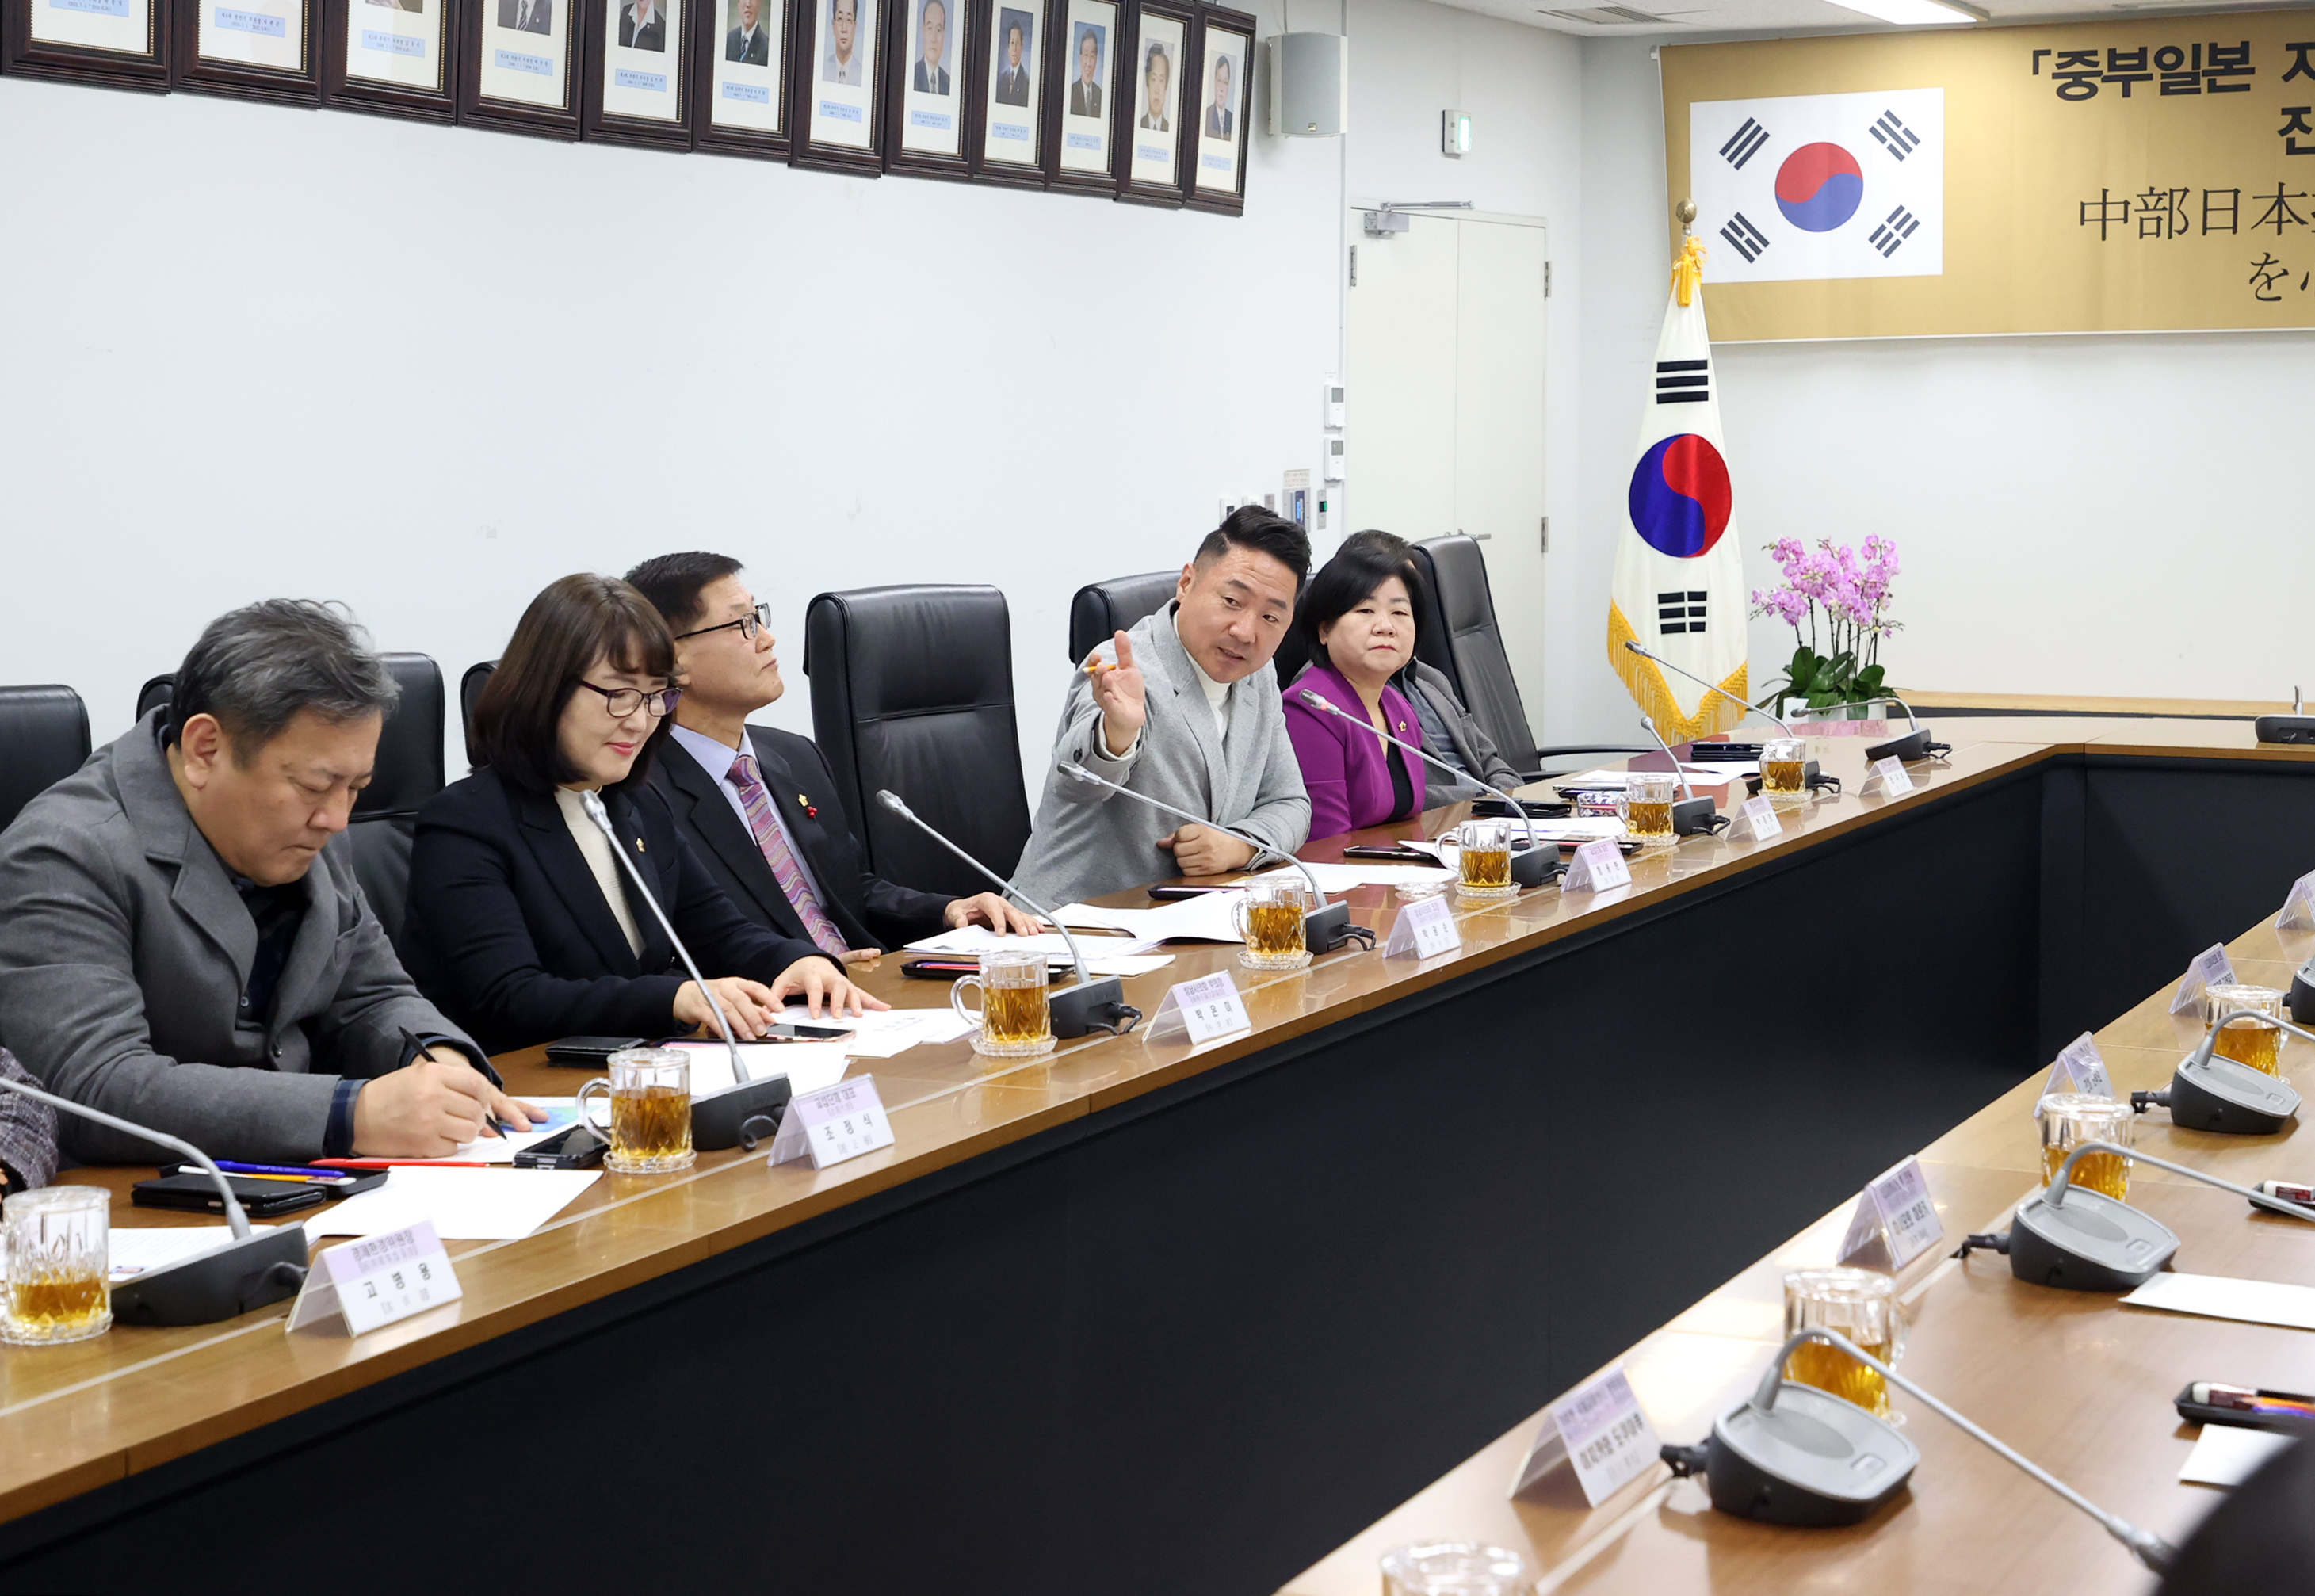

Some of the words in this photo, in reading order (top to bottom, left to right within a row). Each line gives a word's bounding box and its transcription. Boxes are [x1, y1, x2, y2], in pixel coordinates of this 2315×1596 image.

[2080, 181, 2315, 242] 中部日本
[2249, 251, 2315, 302] を
